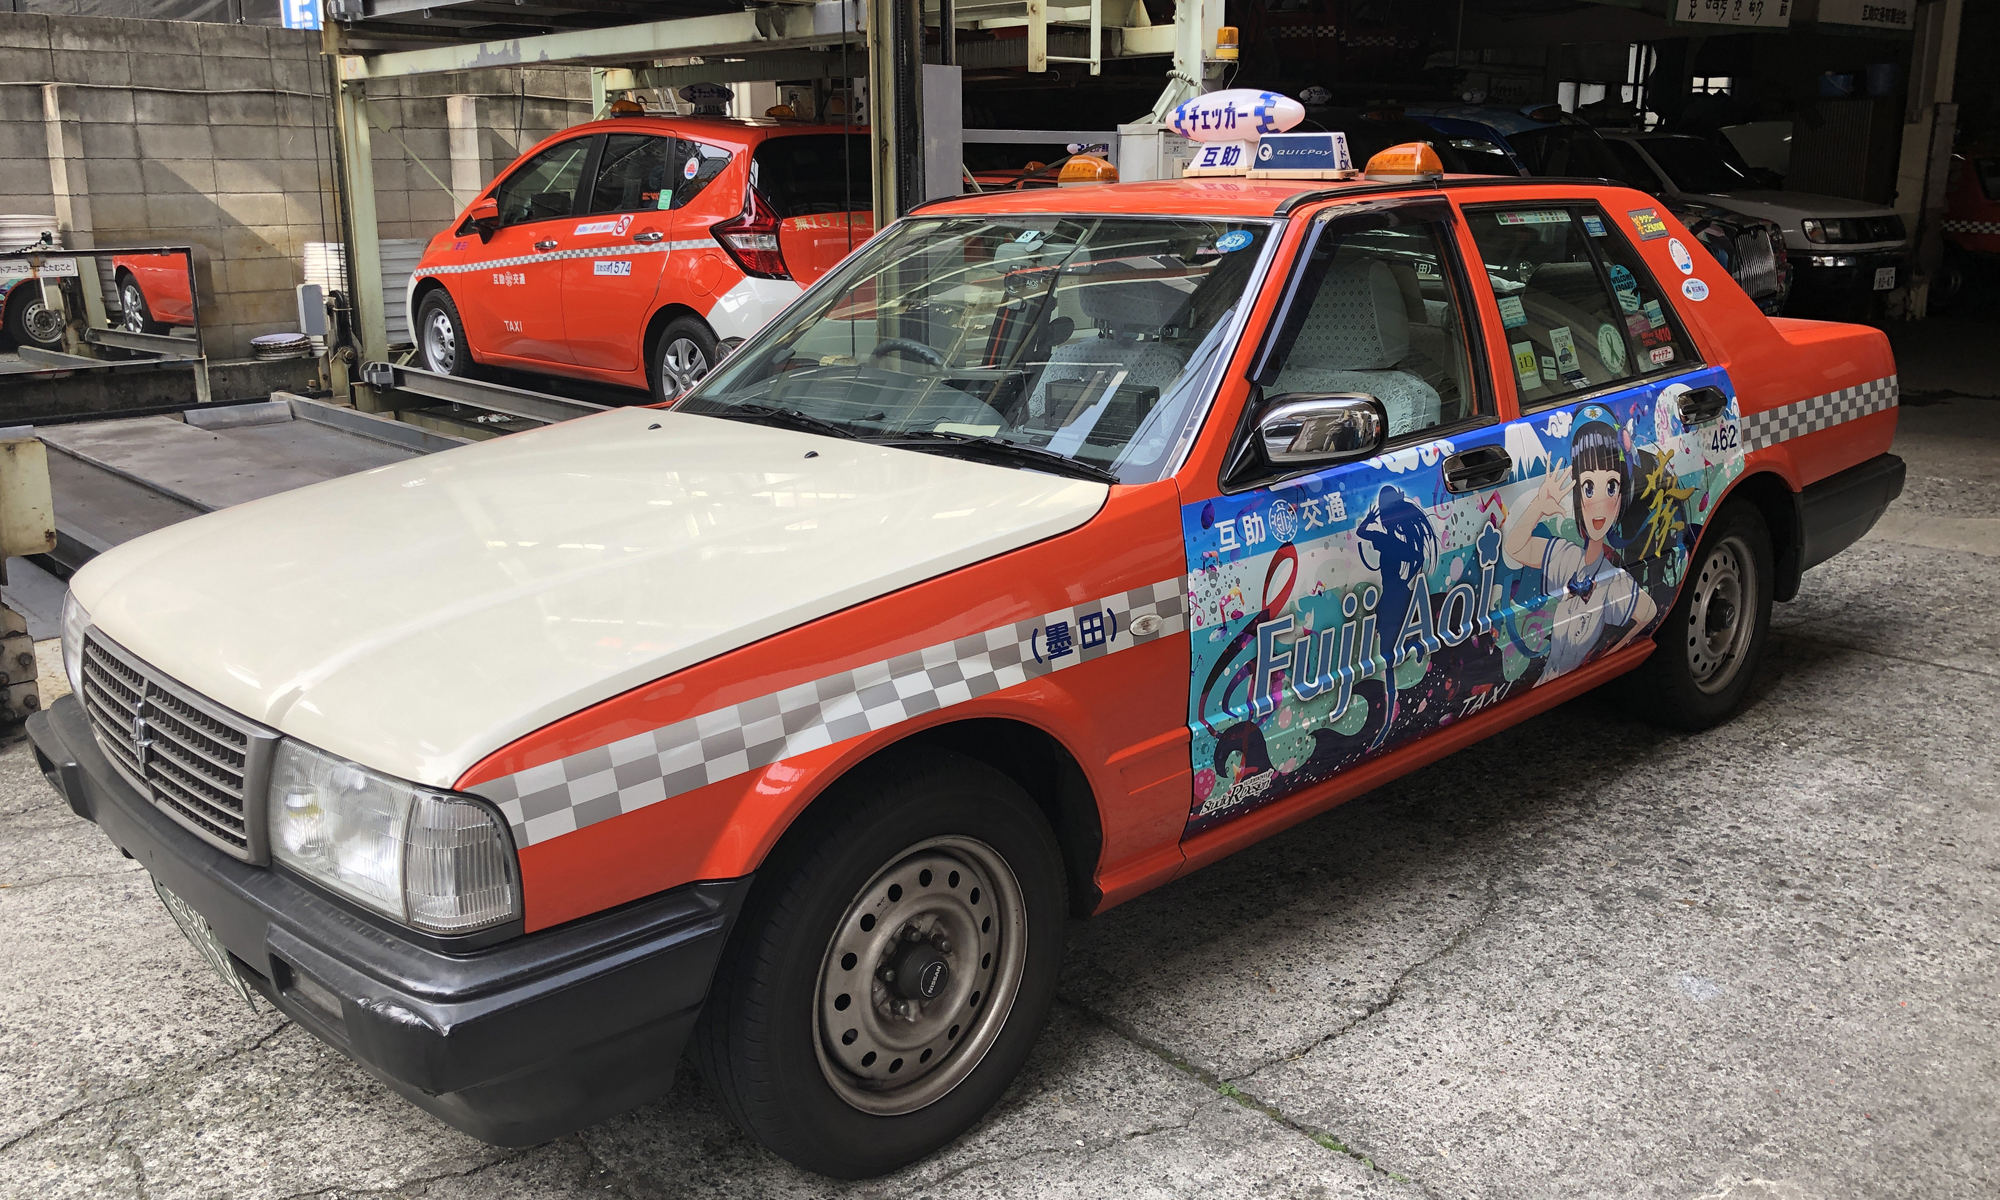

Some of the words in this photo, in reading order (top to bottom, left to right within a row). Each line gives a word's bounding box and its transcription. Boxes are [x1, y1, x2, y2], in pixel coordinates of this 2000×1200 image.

[1188, 101, 1248, 132] チェッカー
[1200, 145, 1241, 167] 互助
[1276, 148, 1332, 157] QUICPay
[610, 261, 631, 274] 1574
[503, 320, 523, 333] TAXI
[1518, 355, 1535, 369] iD
[1711, 424, 1738, 453] 462
[1214, 511, 1267, 553] 互助
[1299, 491, 1348, 532] 交通
[1031, 607, 1118, 665] (墨田)
[1253, 585, 1379, 723] Fuji
[1392, 520, 1502, 668] Aoi
[1458, 680, 1514, 719] TAXI
[927, 965, 942, 994] NISSAN
